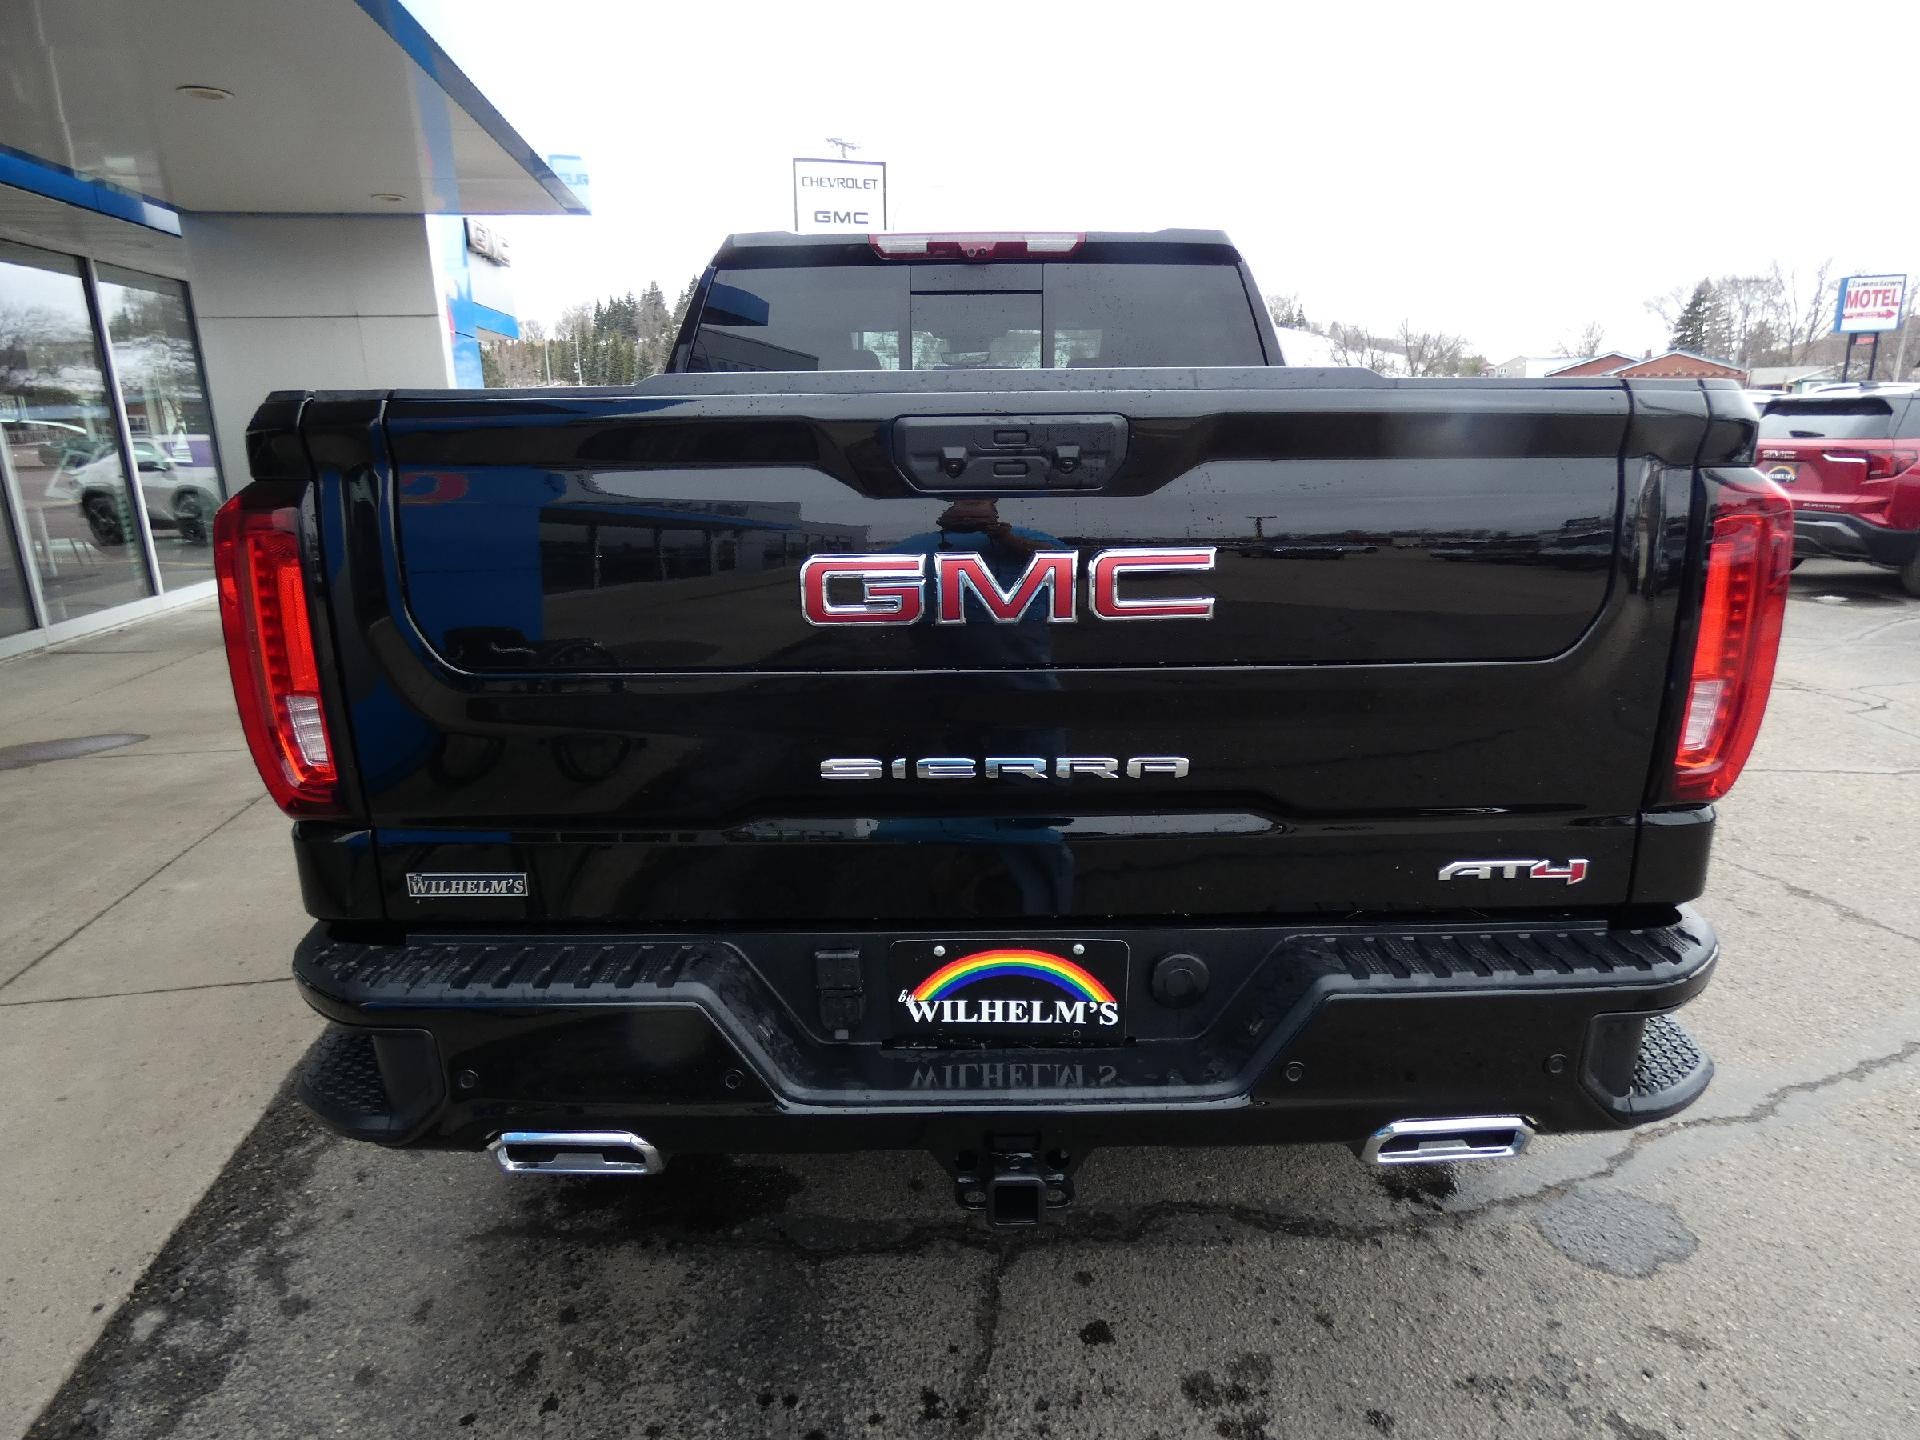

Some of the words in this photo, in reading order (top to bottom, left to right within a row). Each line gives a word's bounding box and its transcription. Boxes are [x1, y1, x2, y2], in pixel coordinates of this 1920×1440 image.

[801, 176, 878, 190] CHEVROLET
[814, 210, 869, 225] GMC
[1845, 288, 1899, 309] MOTEL
[800, 546, 1217, 627] GMC
[820, 757, 1190, 780] SIERRA
[1438, 859, 1590, 885] AT4
[411, 879, 524, 894] WILHELM'S
[906, 1000, 1119, 1026] WILHELM'S
